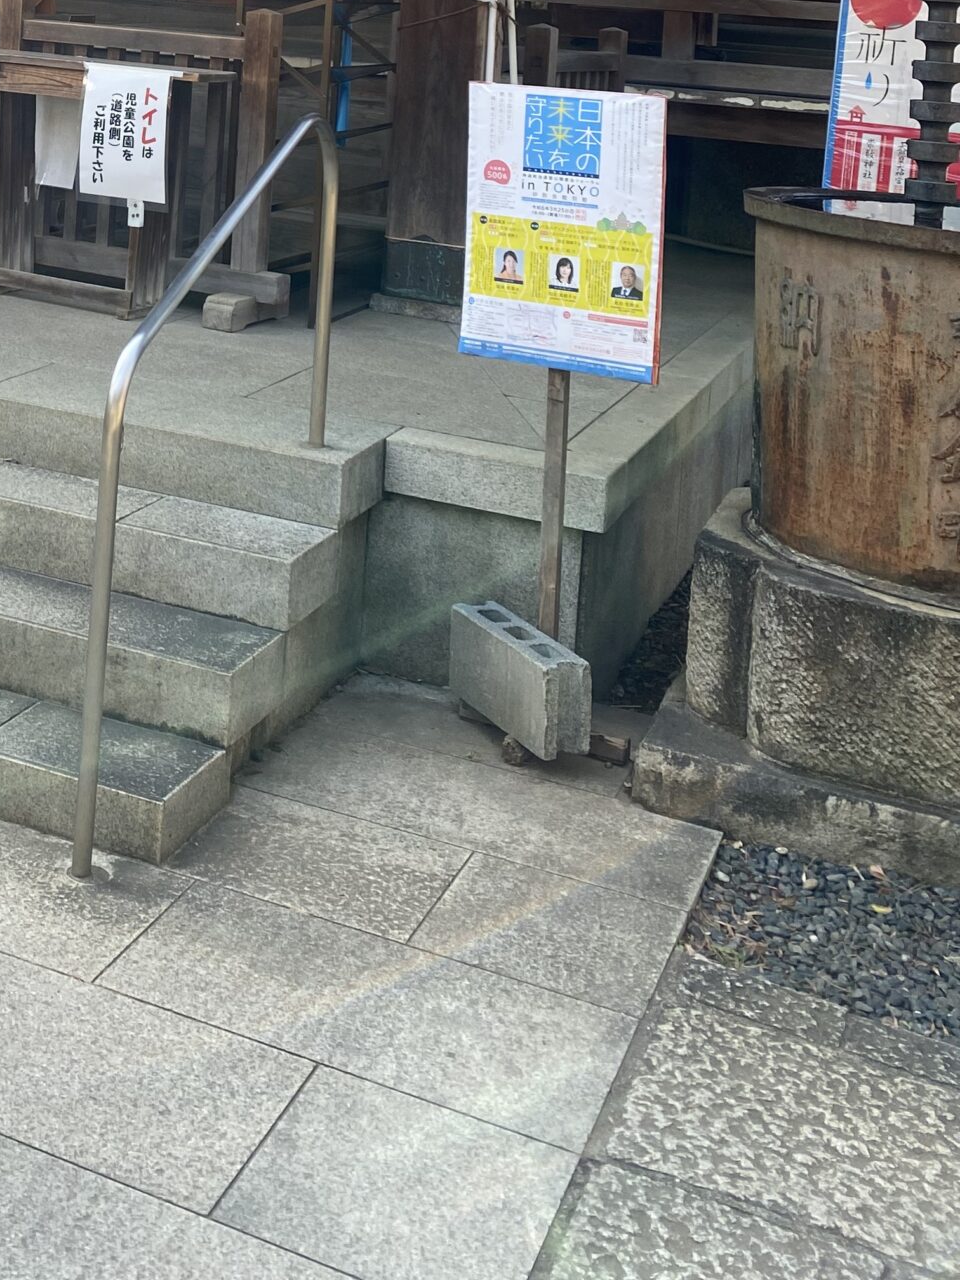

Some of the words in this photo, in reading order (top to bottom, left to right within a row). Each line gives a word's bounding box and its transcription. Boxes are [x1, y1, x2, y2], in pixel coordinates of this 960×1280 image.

[91, 104, 107, 184] ご利用下さい
[122, 92, 137, 162] 児童公園を
[141, 87, 158, 159] トイレは
[525, 96, 547, 167] 守りたい
[546, 96, 575, 170] 未来を
[574, 99, 602, 175] 日本の
[522, 181, 534, 190] in
[544, 182, 599, 197] TOKYO
